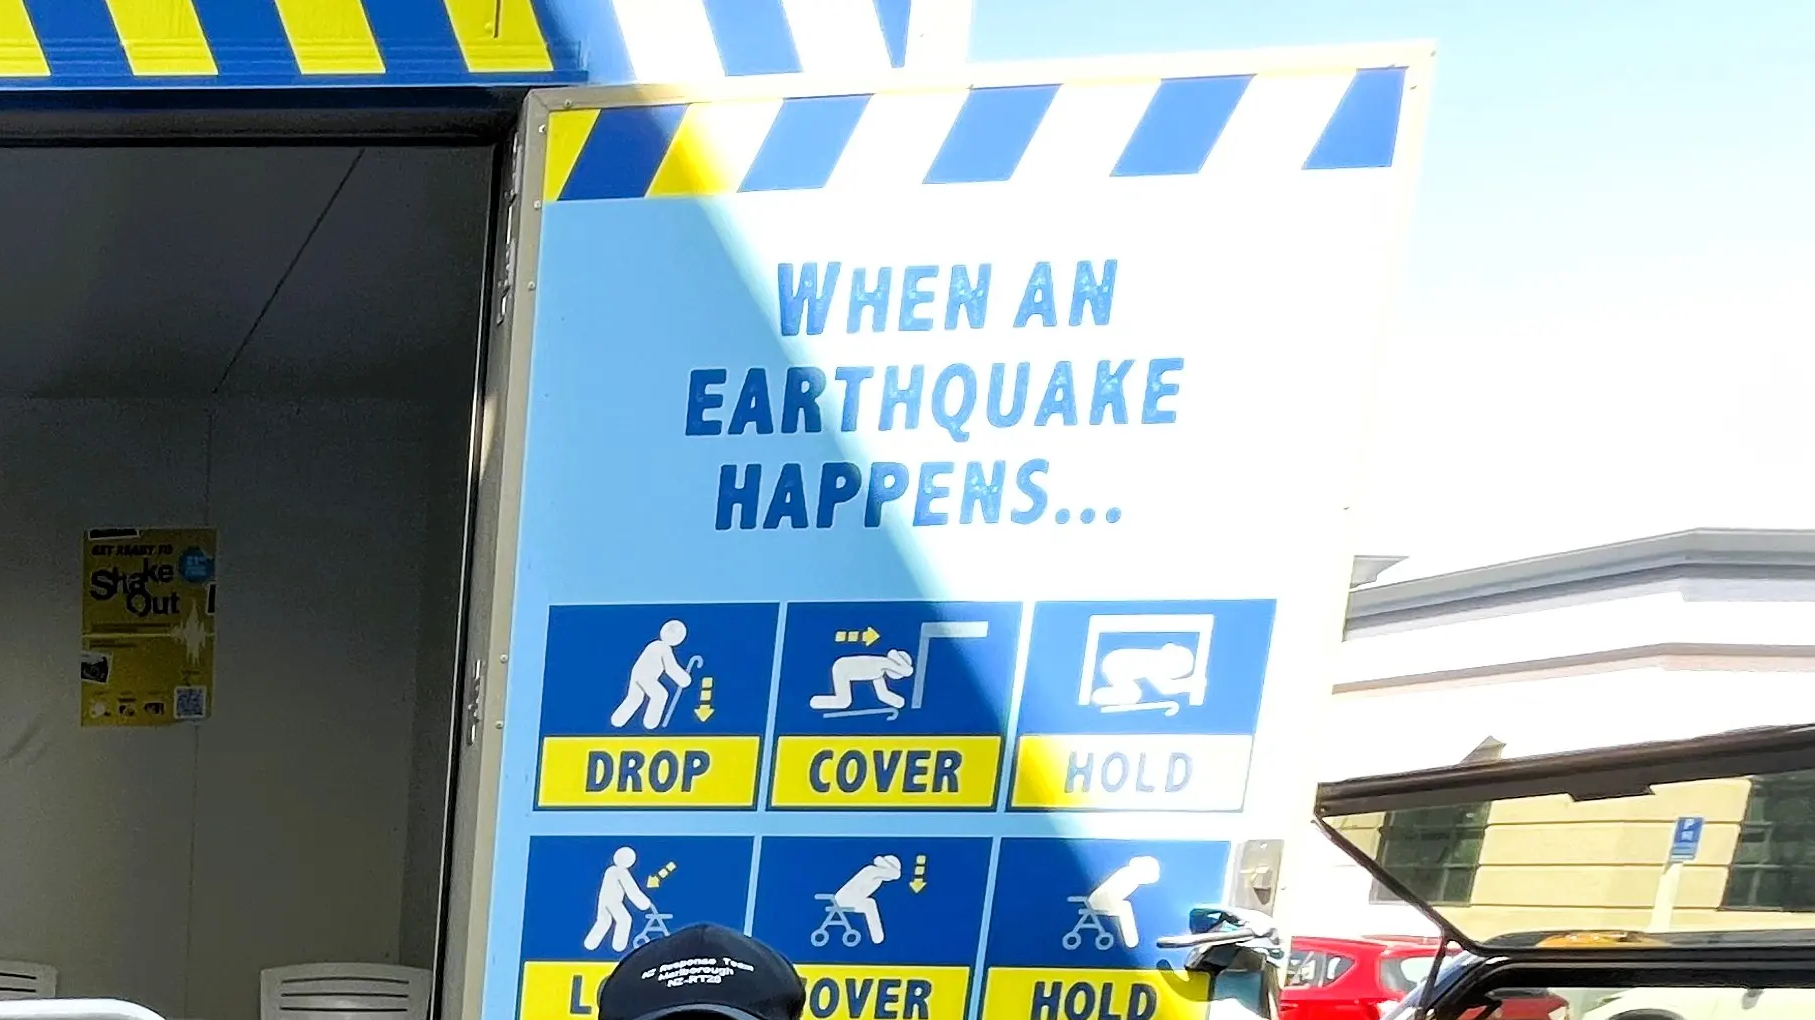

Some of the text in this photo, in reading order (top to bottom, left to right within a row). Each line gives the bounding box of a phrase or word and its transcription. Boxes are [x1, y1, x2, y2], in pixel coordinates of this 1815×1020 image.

[777, 259, 1118, 337] WHEN AN
[685, 357, 1184, 442] EARTHQUAKE
[714, 459, 1122, 531] HAPPENS...
[90, 558, 174, 600] Shake
[127, 590, 180, 617] Out
[586, 750, 711, 793] DROP
[809, 750, 963, 793] COVER
[1063, 750, 1194, 794] HOLD
[799, 977, 933, 1020] OVER
